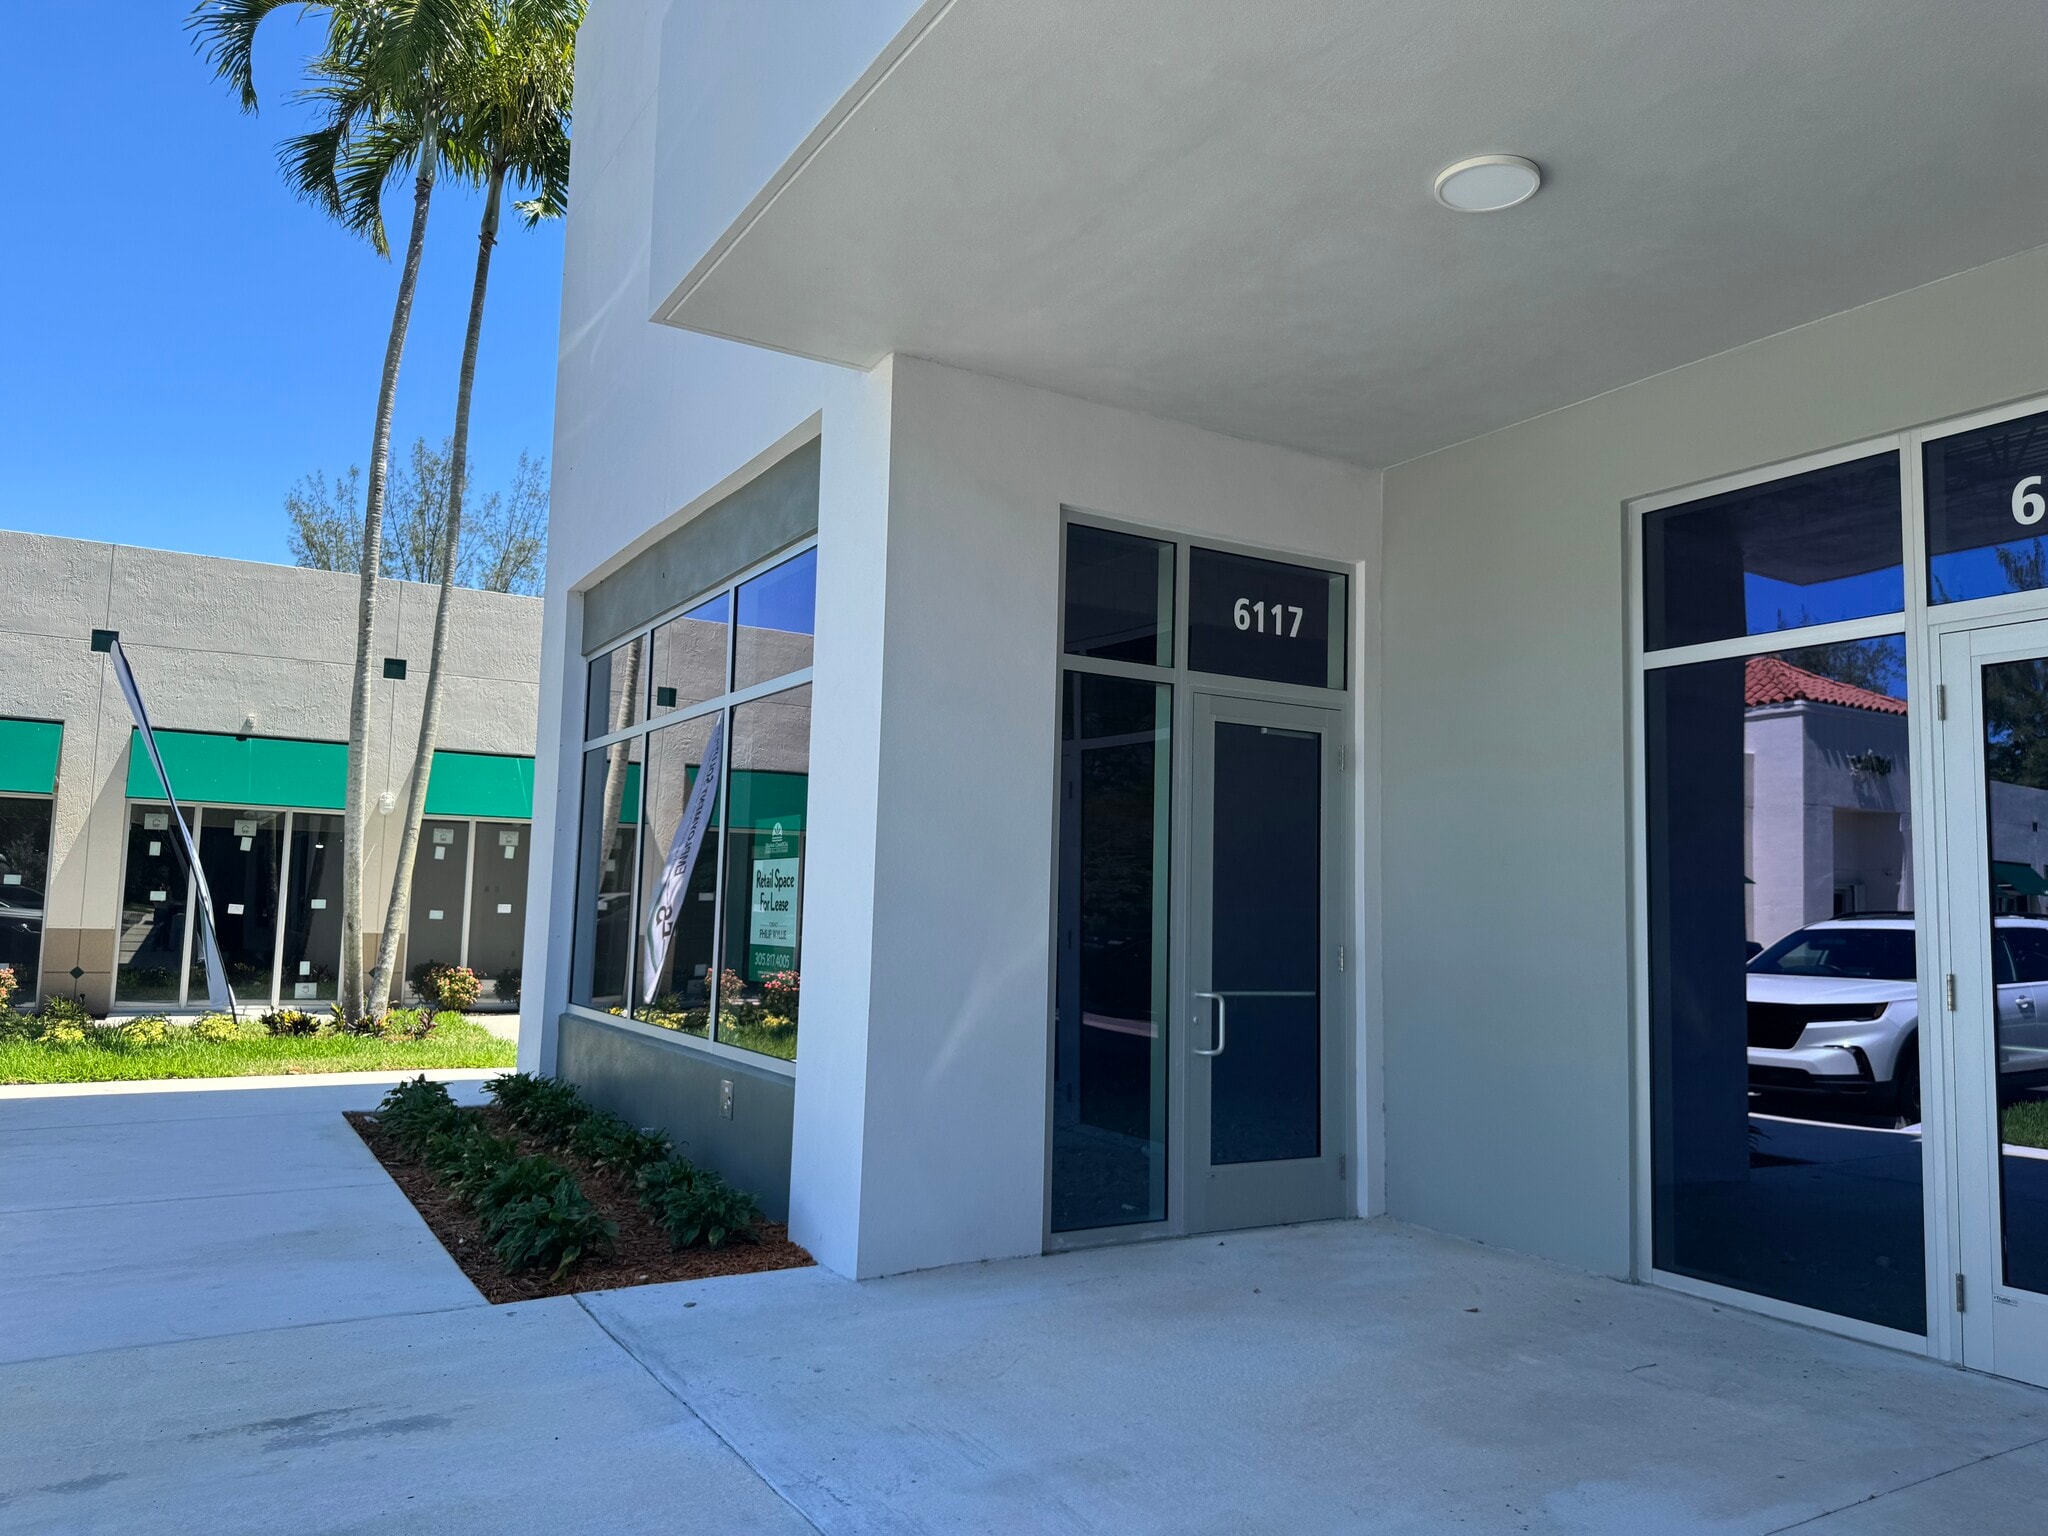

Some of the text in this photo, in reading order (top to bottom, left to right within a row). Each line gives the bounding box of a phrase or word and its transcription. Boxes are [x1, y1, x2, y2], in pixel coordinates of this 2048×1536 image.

[2011, 475, 2046, 525] 6
[1233, 597, 1303, 638] 6117
[756, 868, 795, 892] Retail Space
[759, 891, 789, 912] For Lease
